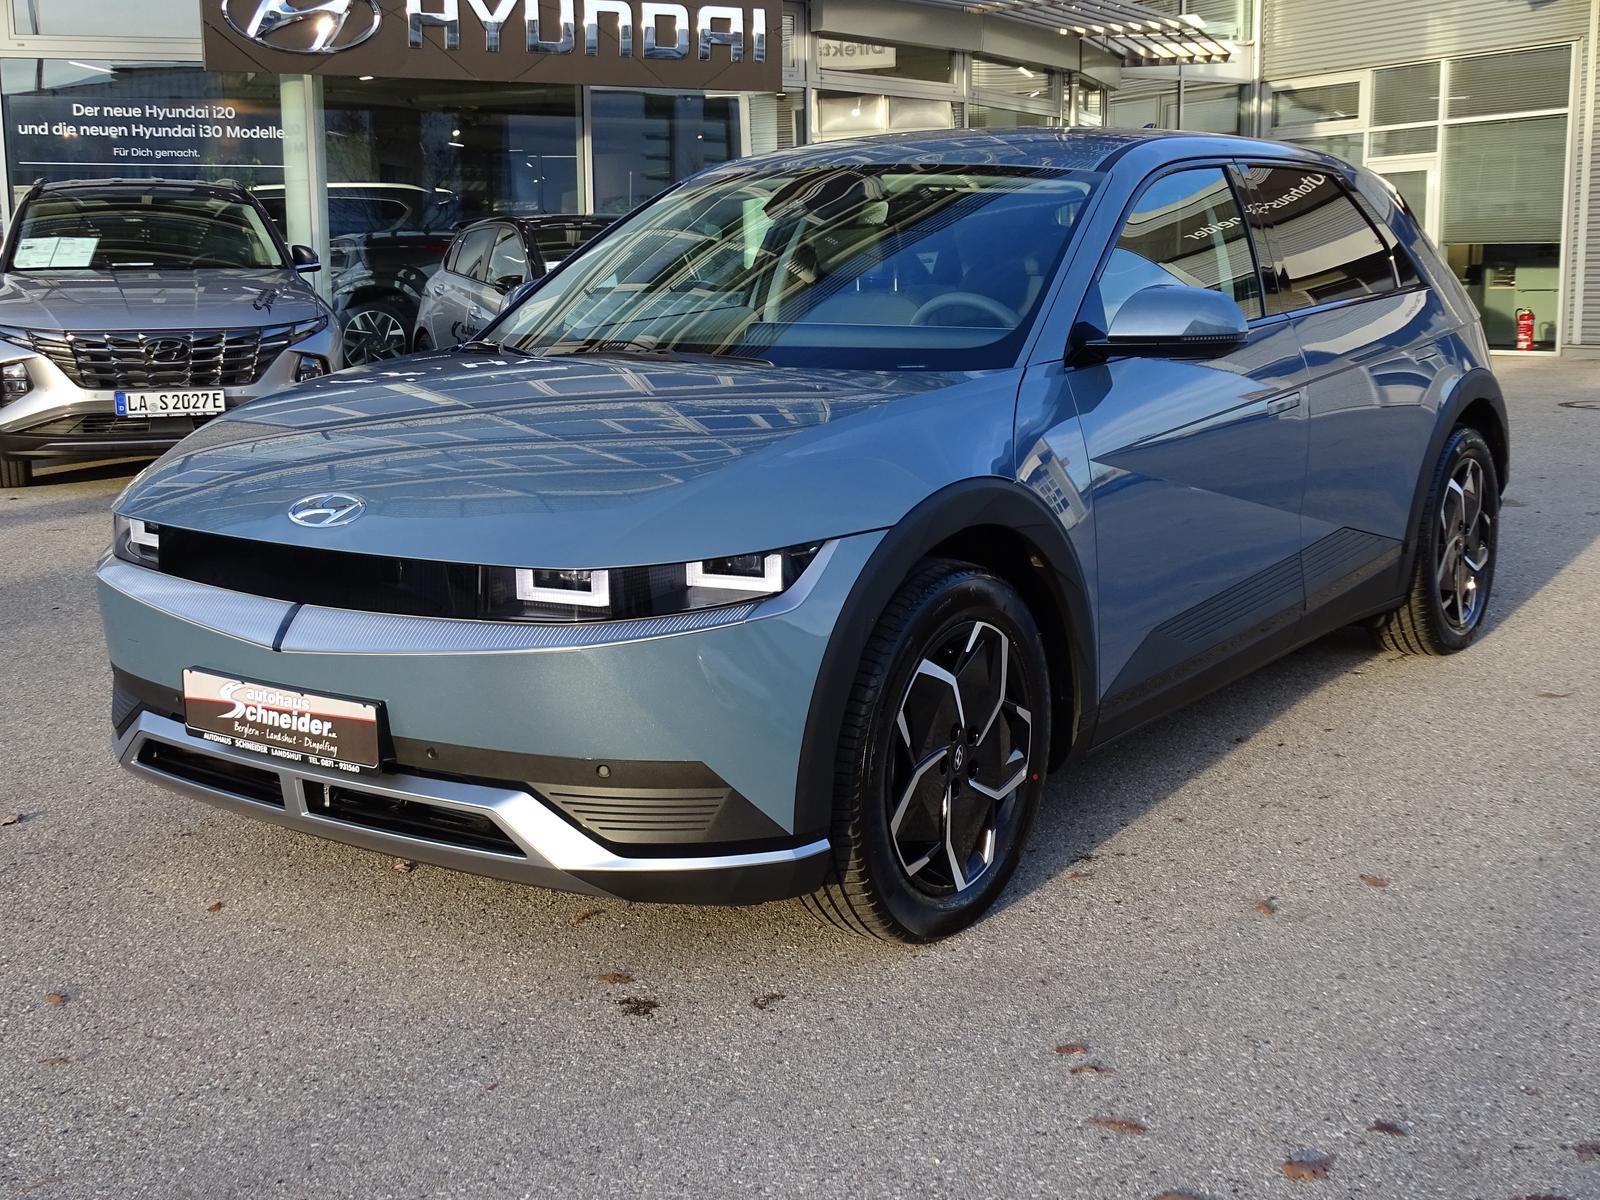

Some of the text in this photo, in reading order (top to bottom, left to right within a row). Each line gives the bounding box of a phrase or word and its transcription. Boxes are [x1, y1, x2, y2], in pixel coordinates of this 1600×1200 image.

[406, 0, 766, 64] HYUNDAI
[72, 103, 236, 120] Der neue Hyundai i20
[18, 122, 49, 135] und
[52, 122, 77, 136] die
[80, 125, 128, 137] neuen
[131, 124, 196, 140] Hyundai
[199, 124, 223, 138] i30
[113, 147, 201, 159] Für Dich gemacht.
[128, 395, 148, 411] LA
[246, 688, 311, 710] autohaus
[203, 732, 232, 745] AUTOHAUS
[235, 739, 268, 754] SCHNEIDER
[271, 748, 303, 761] LANDSHUT
[266, 729, 297, 744] Landshut
[304, 737, 338, 758] Dingolfing
